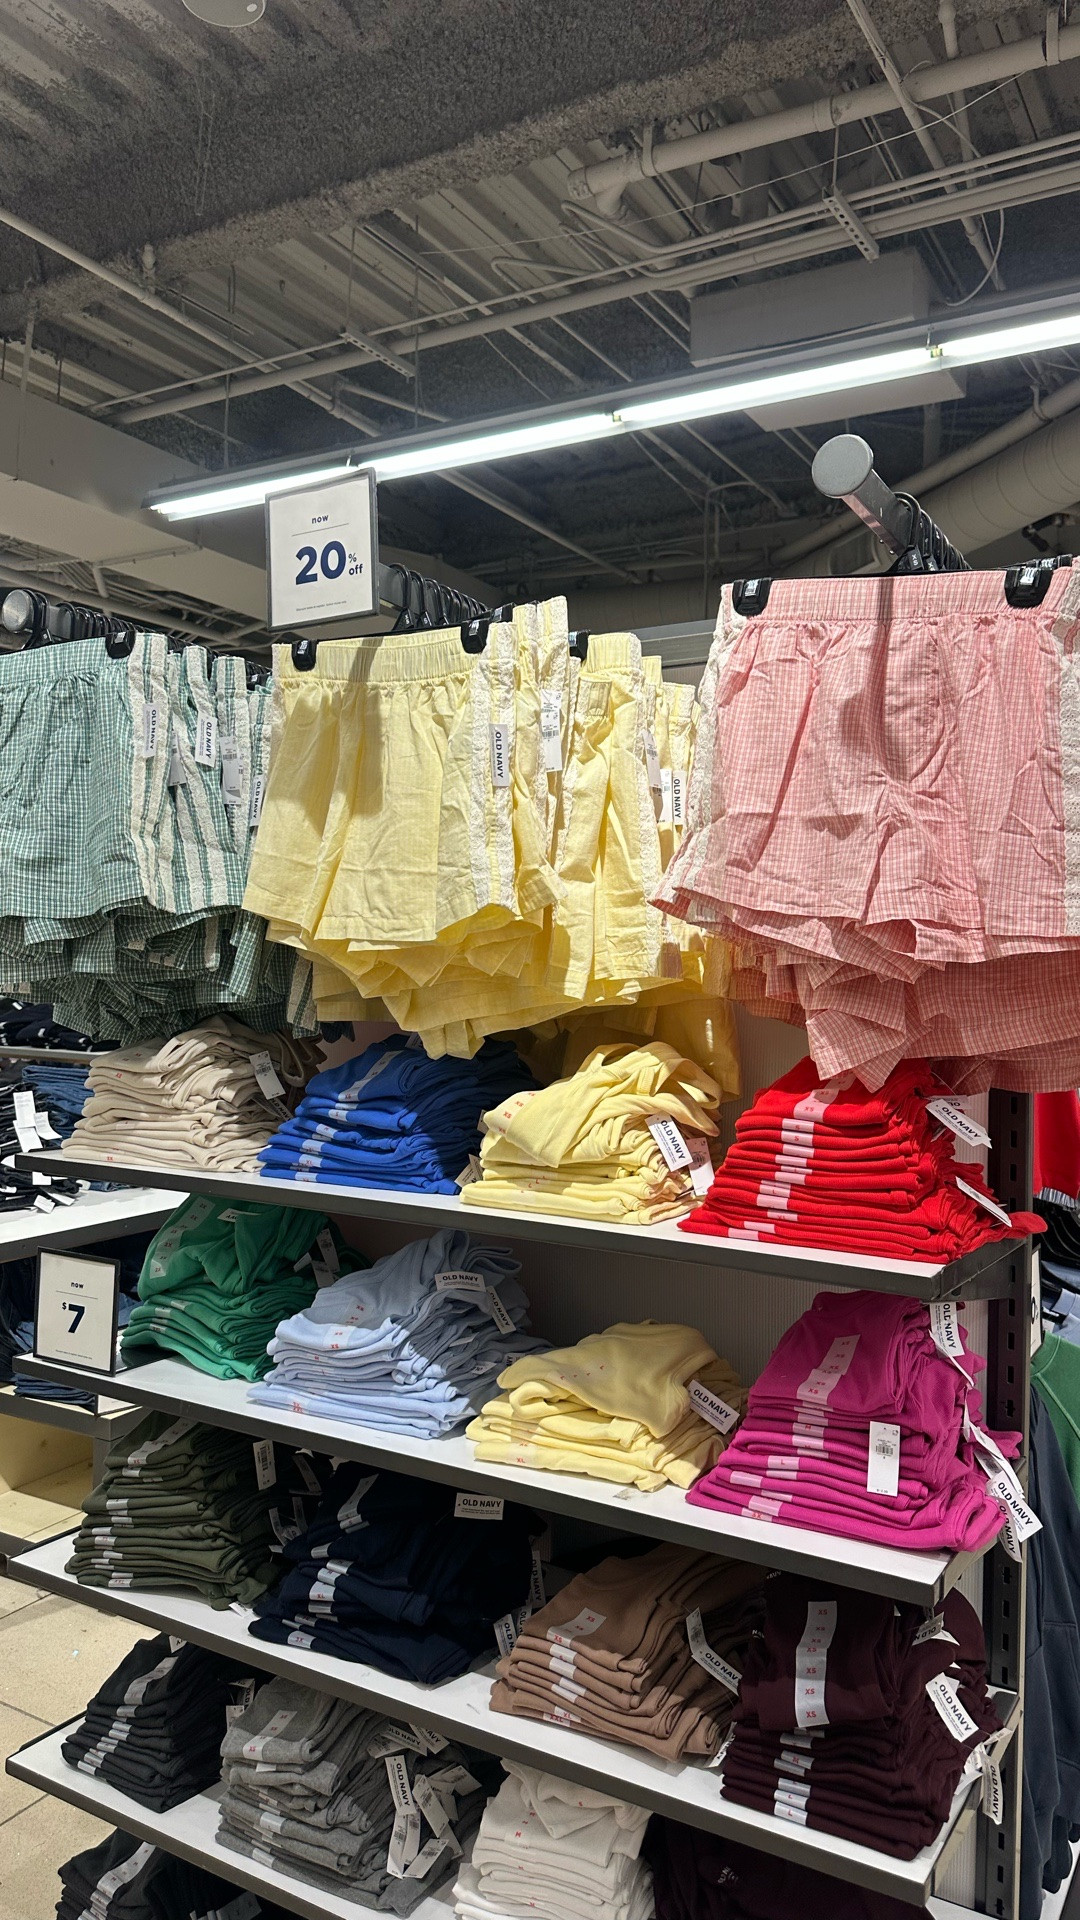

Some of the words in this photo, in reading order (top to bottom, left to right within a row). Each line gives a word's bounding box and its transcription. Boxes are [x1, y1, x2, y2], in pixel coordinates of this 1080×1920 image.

[311, 515, 329, 525] now
[348, 563, 364, 576] off
[496, 752, 504, 778] NAVY
[673, 778, 681, 795] OLD
[673, 796, 681, 818] NAVY
[503, 1111, 512, 1119] XS
[941, 1107, 958, 1121] OLD
[956, 1120, 981, 1138] NAVY
[660, 1120, 673, 1136] OLD
[669, 1137, 686, 1160] NAVY
[71, 1281, 84, 1289] now
[458, 1274, 478, 1282] NAVY
[497, 1307, 511, 1326] NAVY
[943, 1303, 951, 1321] OLD
[945, 1323, 957, 1349] NAVY
[693, 1389, 709, 1403] OLD
[708, 1400, 731, 1419] NAVY
[462, 1498, 478, 1507] OLD
[479, 1500, 502, 1508] NAVY
[997, 1482, 1012, 1501] OLD
[1010, 1500, 1034, 1525] NAVY
[1004, 1525, 1016, 1554] NAVY
[586, 1615, 596, 1623] XS
[504, 1622, 513, 1640] OLD
[553, 1634, 563, 1643] XS
[705, 1652, 721, 1668] OLD
[720, 1665, 740, 1681] NAV
[939, 1684, 953, 1704] OLD
[950, 1704, 973, 1732] NAVY
[425, 1729, 441, 1743] AVY
[396, 1763, 404, 1781] OLD
[990, 1765, 998, 1786] OLD
[399, 1782, 411, 1806] NAVY
[787, 1809, 793, 1817] L
